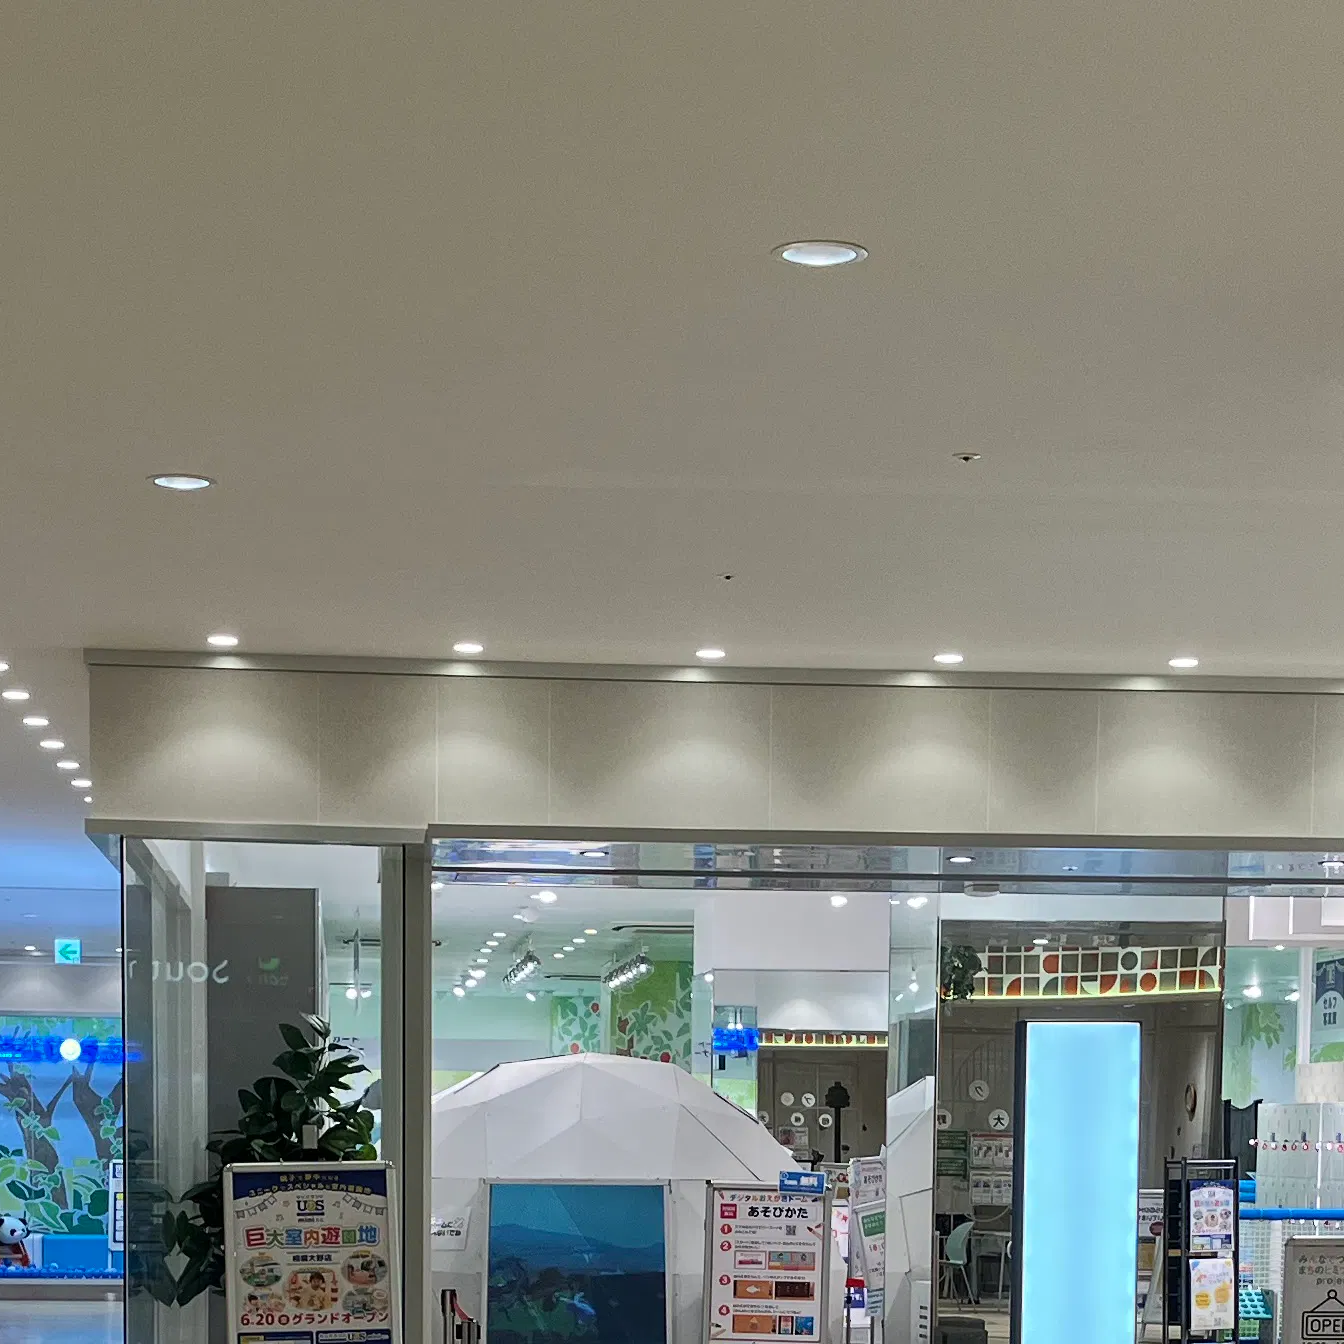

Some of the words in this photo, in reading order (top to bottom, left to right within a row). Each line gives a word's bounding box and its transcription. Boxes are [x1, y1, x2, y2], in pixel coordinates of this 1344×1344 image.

[747, 1205, 809, 1219] あそびかた
[244, 1225, 379, 1248] 巨大室内遊園地
